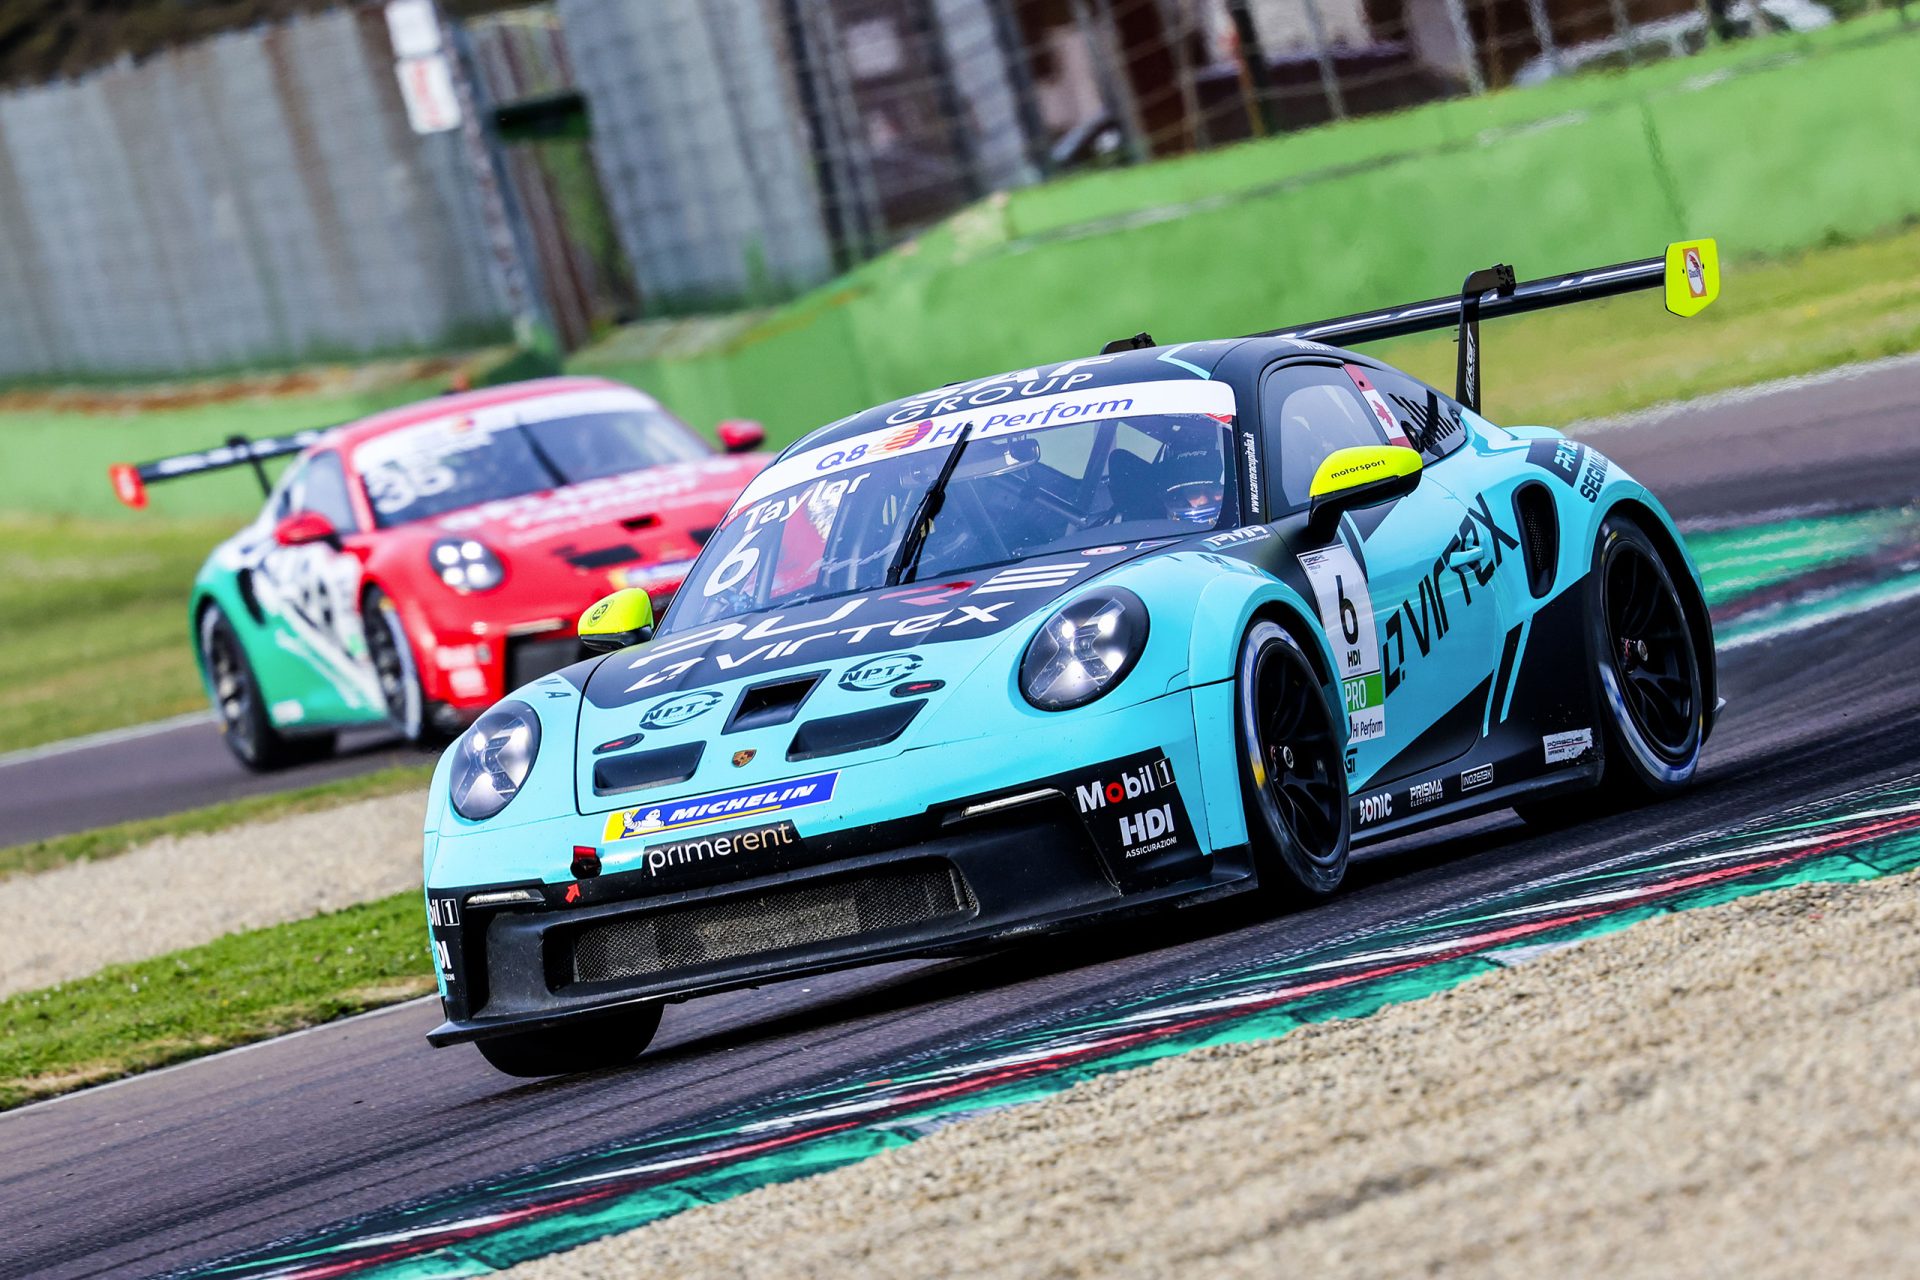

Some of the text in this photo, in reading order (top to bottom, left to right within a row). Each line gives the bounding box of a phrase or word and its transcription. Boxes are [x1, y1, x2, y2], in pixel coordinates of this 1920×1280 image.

[886, 373, 1094, 425] GROUP
[816, 398, 1133, 471] Q8 H Perform
[1331, 459, 1386, 479] motorsport
[744, 472, 871, 533] Taylor
[703, 528, 762, 597] 6
[1335, 574, 1359, 645] 6
[841, 665, 903, 685] NPT
[1346, 649, 1362, 668] HDI
[1344, 678, 1367, 710] PRO
[644, 703, 697, 722] NPT
[1352, 717, 1384, 739] Hi Perform
[669, 783, 818, 822] MICHELIN
[1076, 760, 1171, 813] Mobil 1
[1410, 779, 1443, 801] PRISMA
[1410, 792, 1443, 808] ELECTRONICS
[1119, 803, 1175, 847] HDI
[1359, 792, 1393, 825] SONIC
[648, 823, 793, 877] primerent
[1125, 836, 1178, 859] ASSICURAZIONI
